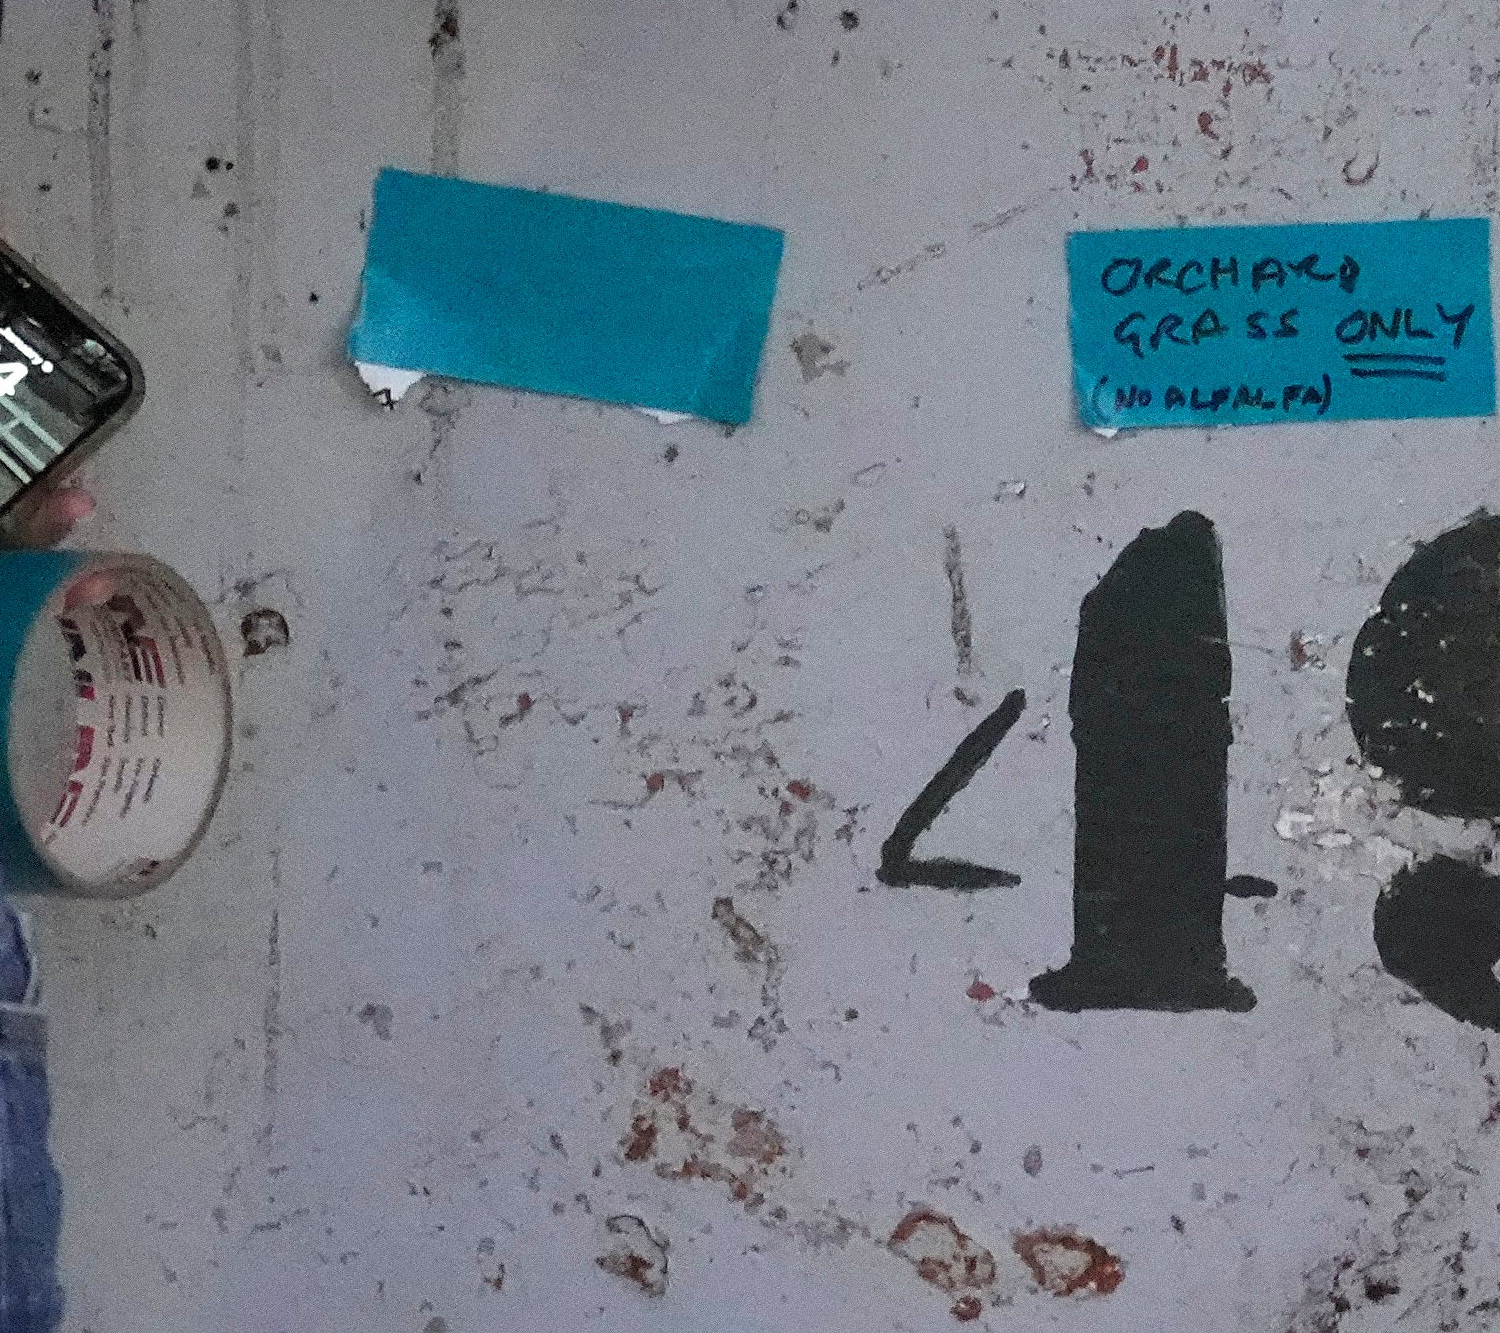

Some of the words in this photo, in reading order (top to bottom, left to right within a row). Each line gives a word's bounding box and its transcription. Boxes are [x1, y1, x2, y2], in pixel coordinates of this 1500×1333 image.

[1101, 253, 1361, 296] ORCHARD
[1113, 308, 1300, 359] GRASS
[1335, 302, 1476, 350] ONLY
